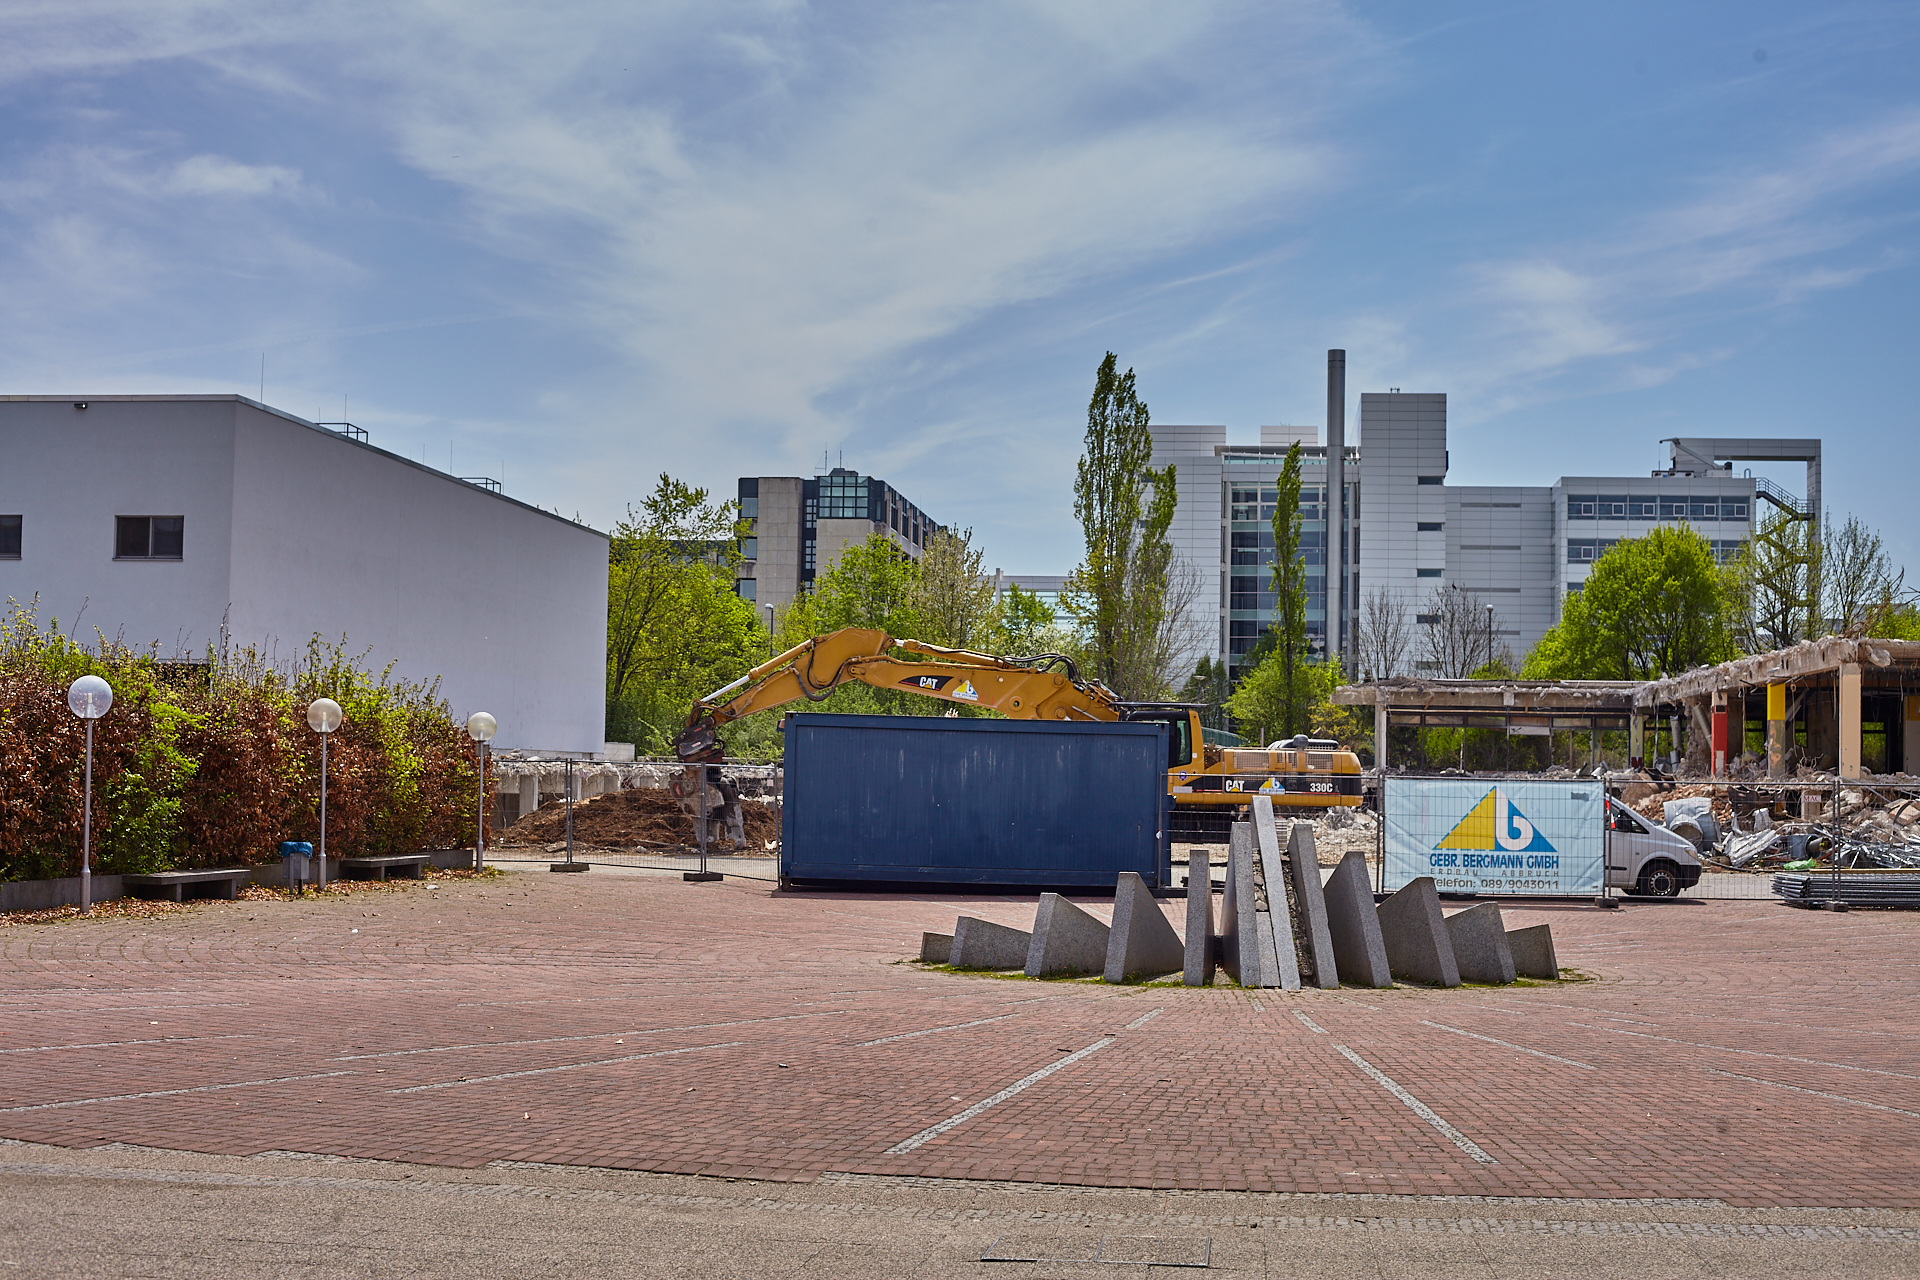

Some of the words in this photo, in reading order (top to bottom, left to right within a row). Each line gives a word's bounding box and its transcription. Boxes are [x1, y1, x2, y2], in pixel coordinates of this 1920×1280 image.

[919, 676, 938, 690] CAT
[1225, 780, 1245, 792] CAT
[1310, 783, 1333, 792] 330C
[1430, 853, 1460, 867] GEBR.
[1463, 854, 1523, 868] BERGMANN
[1527, 855, 1559, 869] GMBH
[1430, 868, 1478, 876] ERDBAU
[1481, 879, 1558, 889] 089/9043011
